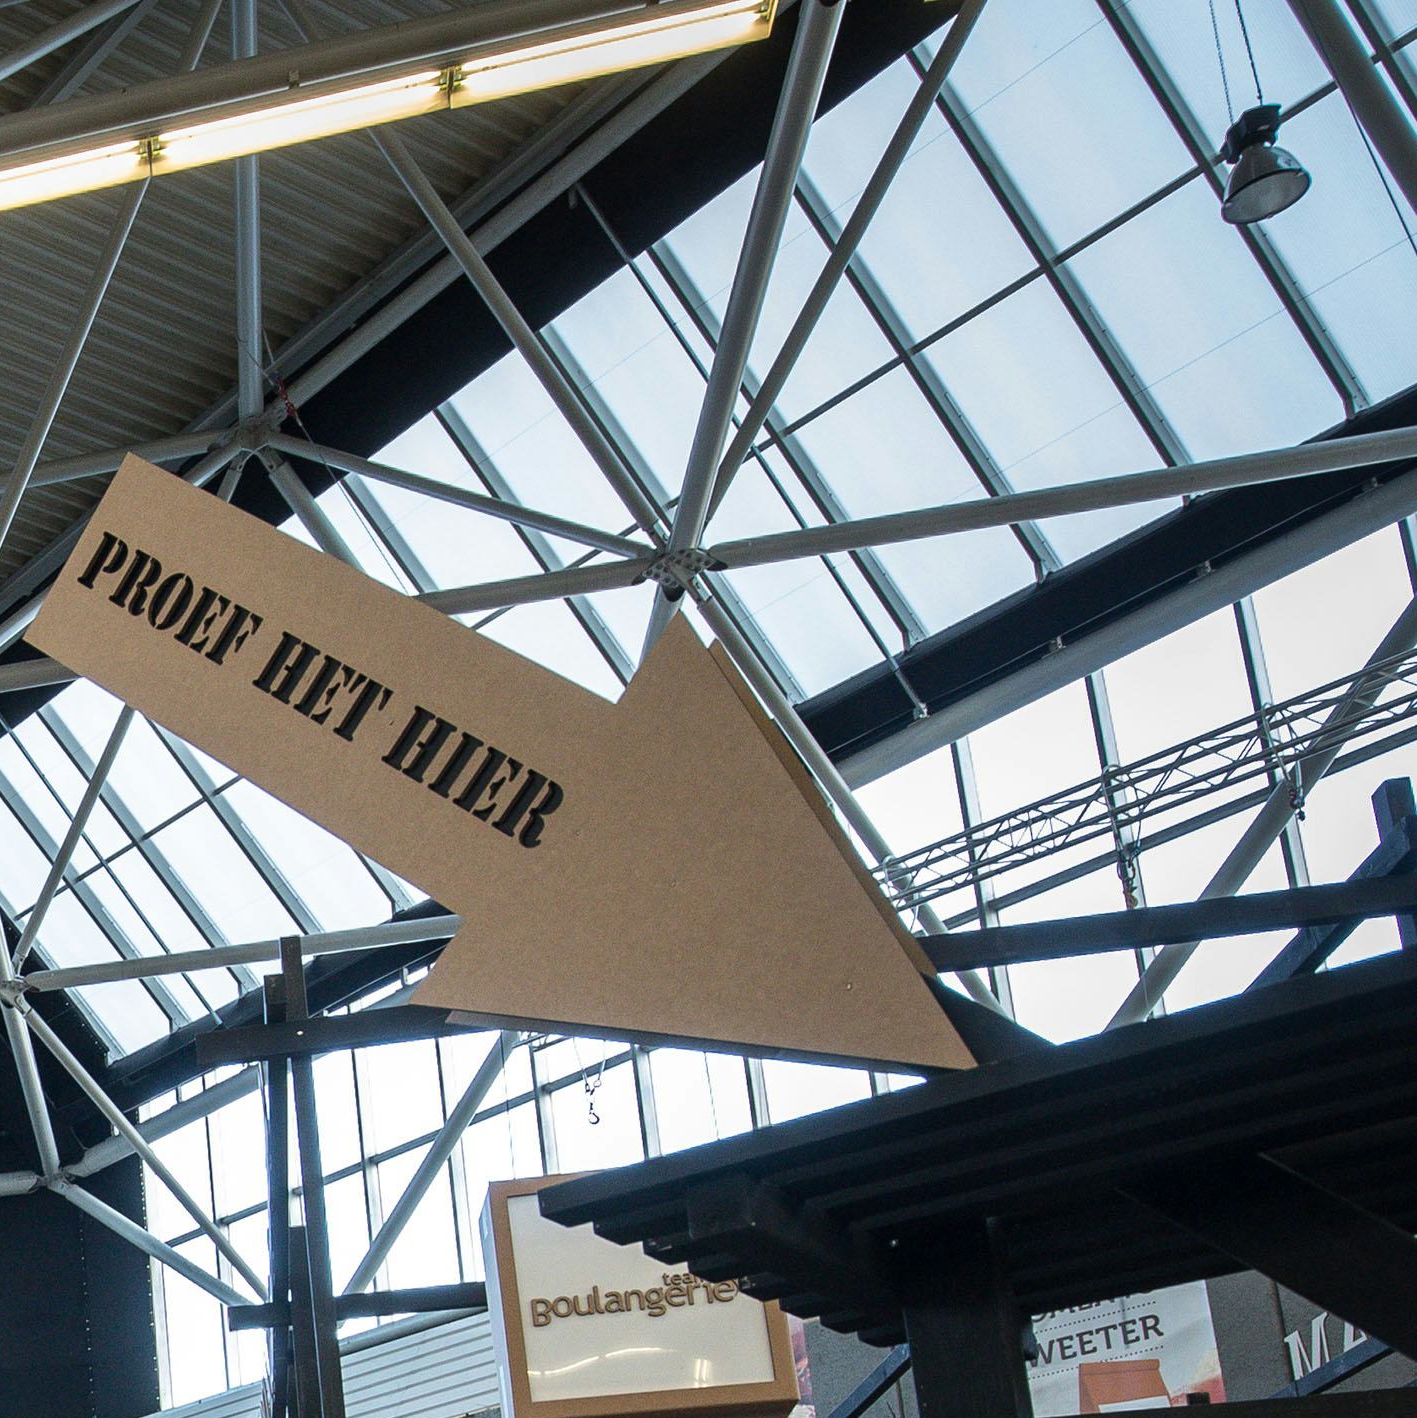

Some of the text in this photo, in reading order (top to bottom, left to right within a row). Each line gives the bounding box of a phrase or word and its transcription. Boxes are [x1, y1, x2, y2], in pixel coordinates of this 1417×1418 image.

[76, 530, 565, 850] PROEF HET HIER
[662, 1272, 703, 1287] tea
[1030, 1314, 1164, 1368] WEETER
